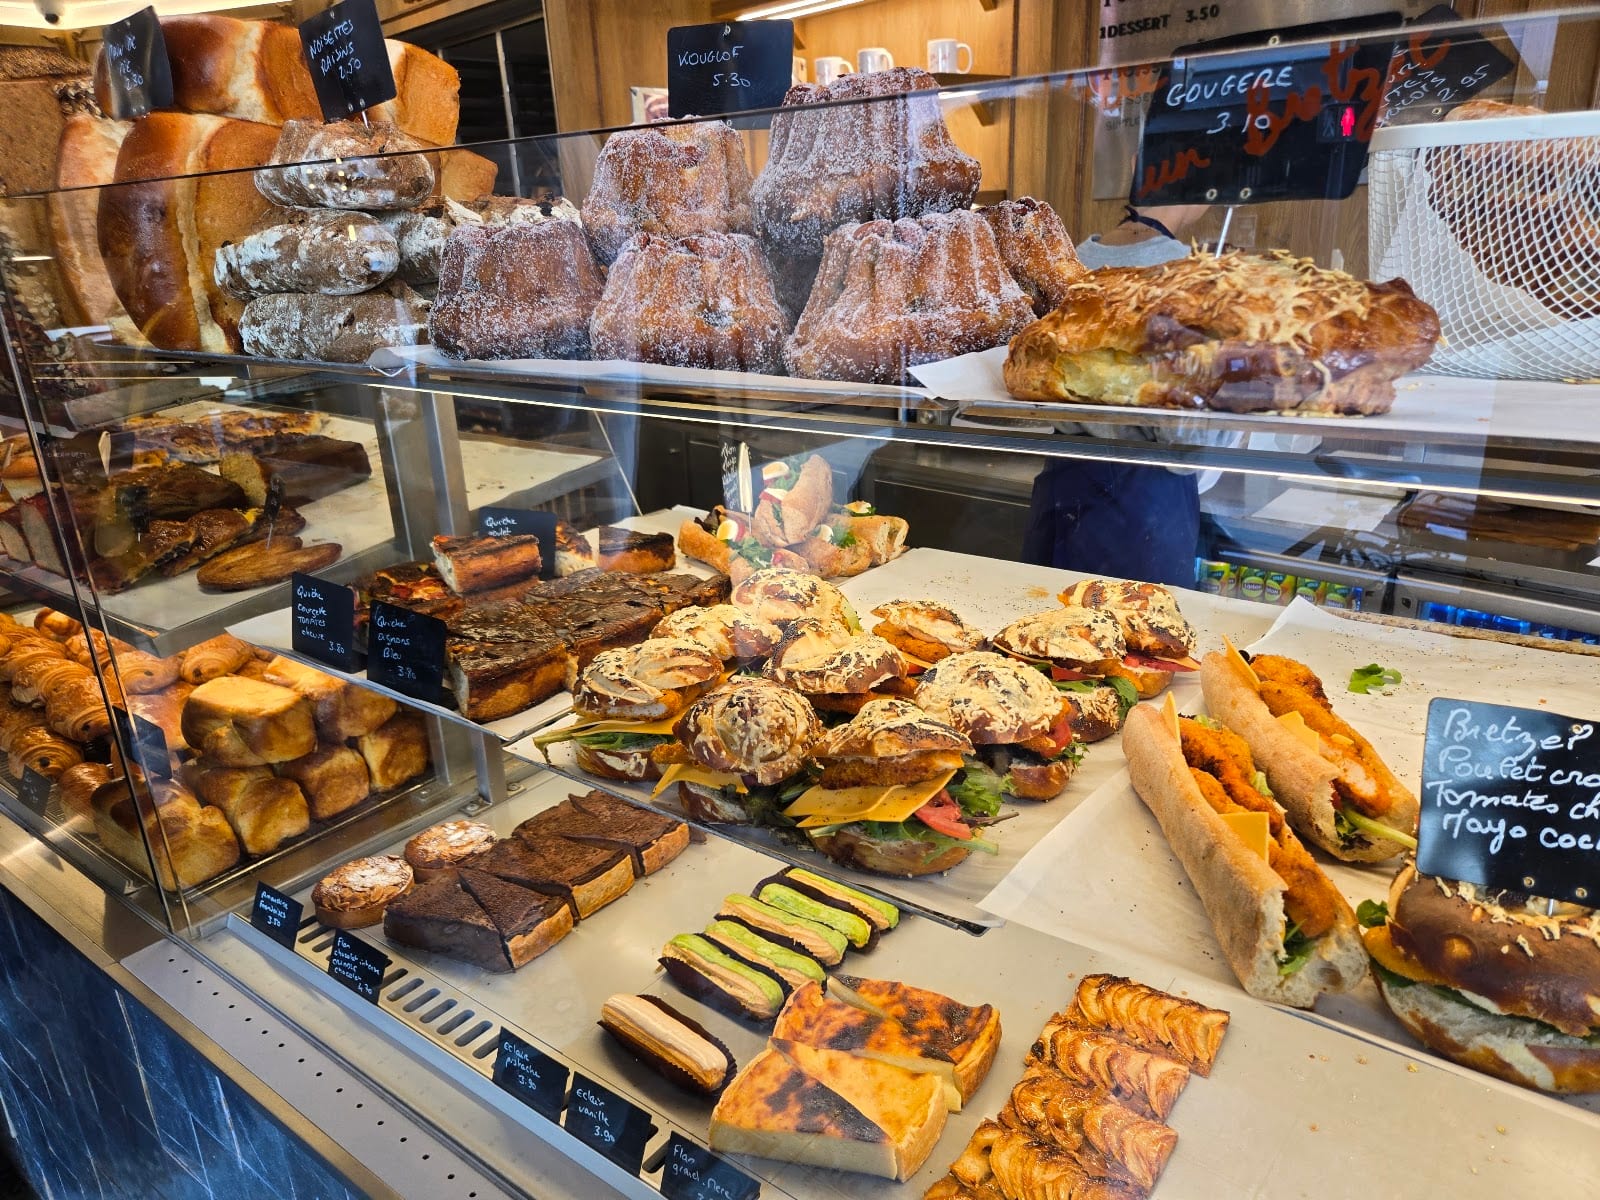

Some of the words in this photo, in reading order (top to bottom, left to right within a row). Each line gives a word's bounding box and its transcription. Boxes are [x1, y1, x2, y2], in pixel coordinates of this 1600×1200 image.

[1185, 4, 1219, 23] 3.50
[678, 45, 745, 67] KOUGLOF
[712, 72, 751, 87] 5.30
[1166, 65, 1294, 106] GOUGERE
[1436, 63, 1490, 104] 2.95
[1206, 110, 1271, 134] 3.10
[1443, 708, 1594, 760] Bretzel
[1438, 745, 1547, 782] Poulet
[1426, 779, 1559, 814] Tomates
[518, 1074, 537, 1090] 3.90
[578, 1104, 610, 1127] vanille
[673, 1144, 696, 1164] Flan
